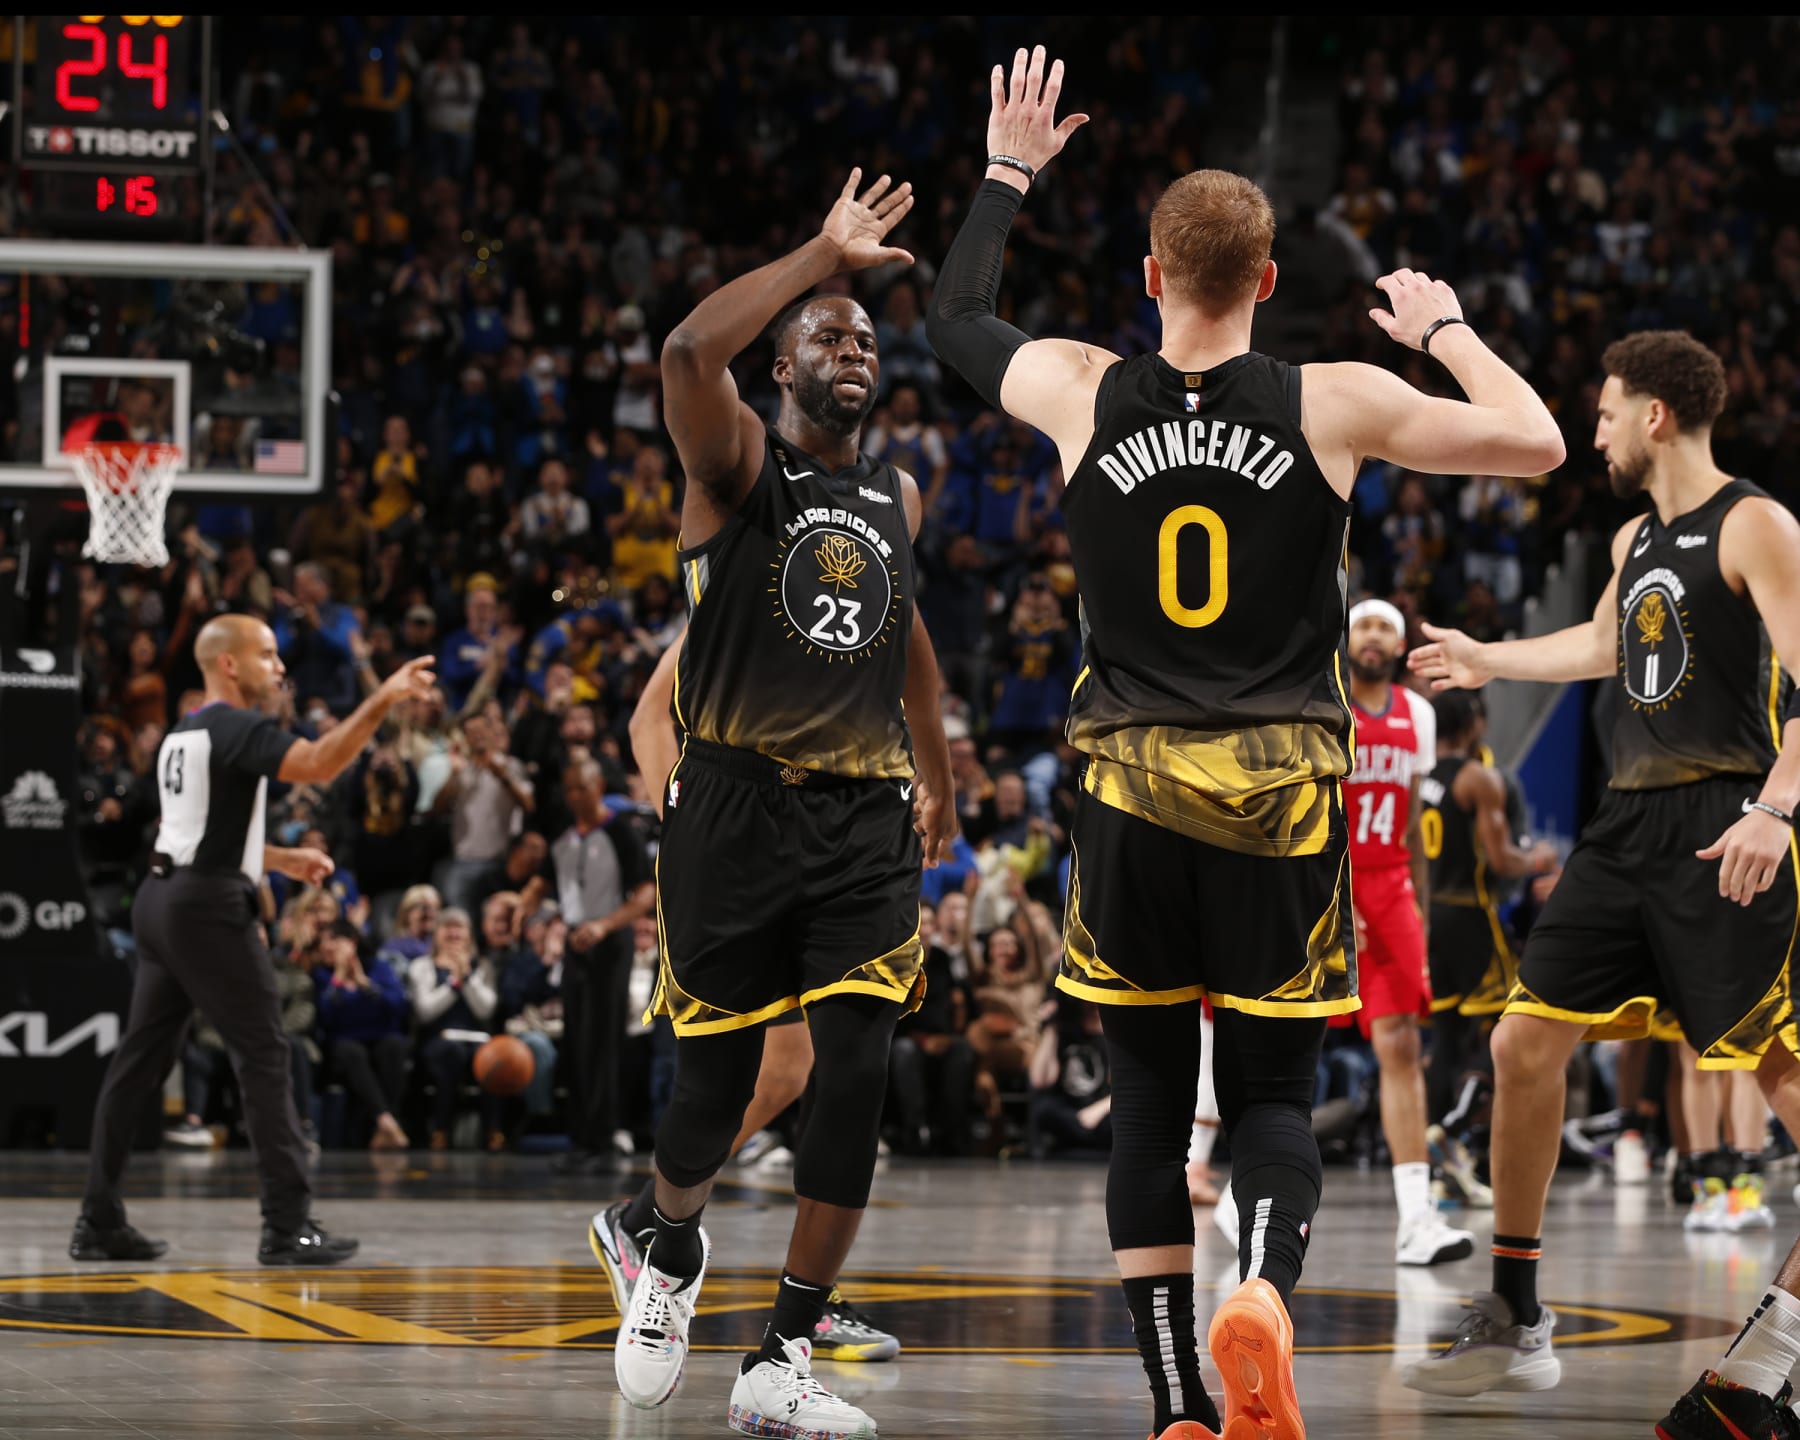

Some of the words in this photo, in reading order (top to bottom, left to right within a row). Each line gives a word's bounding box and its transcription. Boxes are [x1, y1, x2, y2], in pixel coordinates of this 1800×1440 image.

[56, 24, 169, 111] 24
[1097, 419, 1295, 495] DIVINCENZO
[858, 486, 893, 504] Rakuten
[785, 508, 893, 558] WARRIORS
[1158, 504, 1229, 628] 0
[809, 594, 862, 645] 23
[1643, 653, 1660, 697] 11
[164, 747, 185, 796] 43
[1356, 791, 1397, 846] 14
[35, 900, 86, 931] GP
